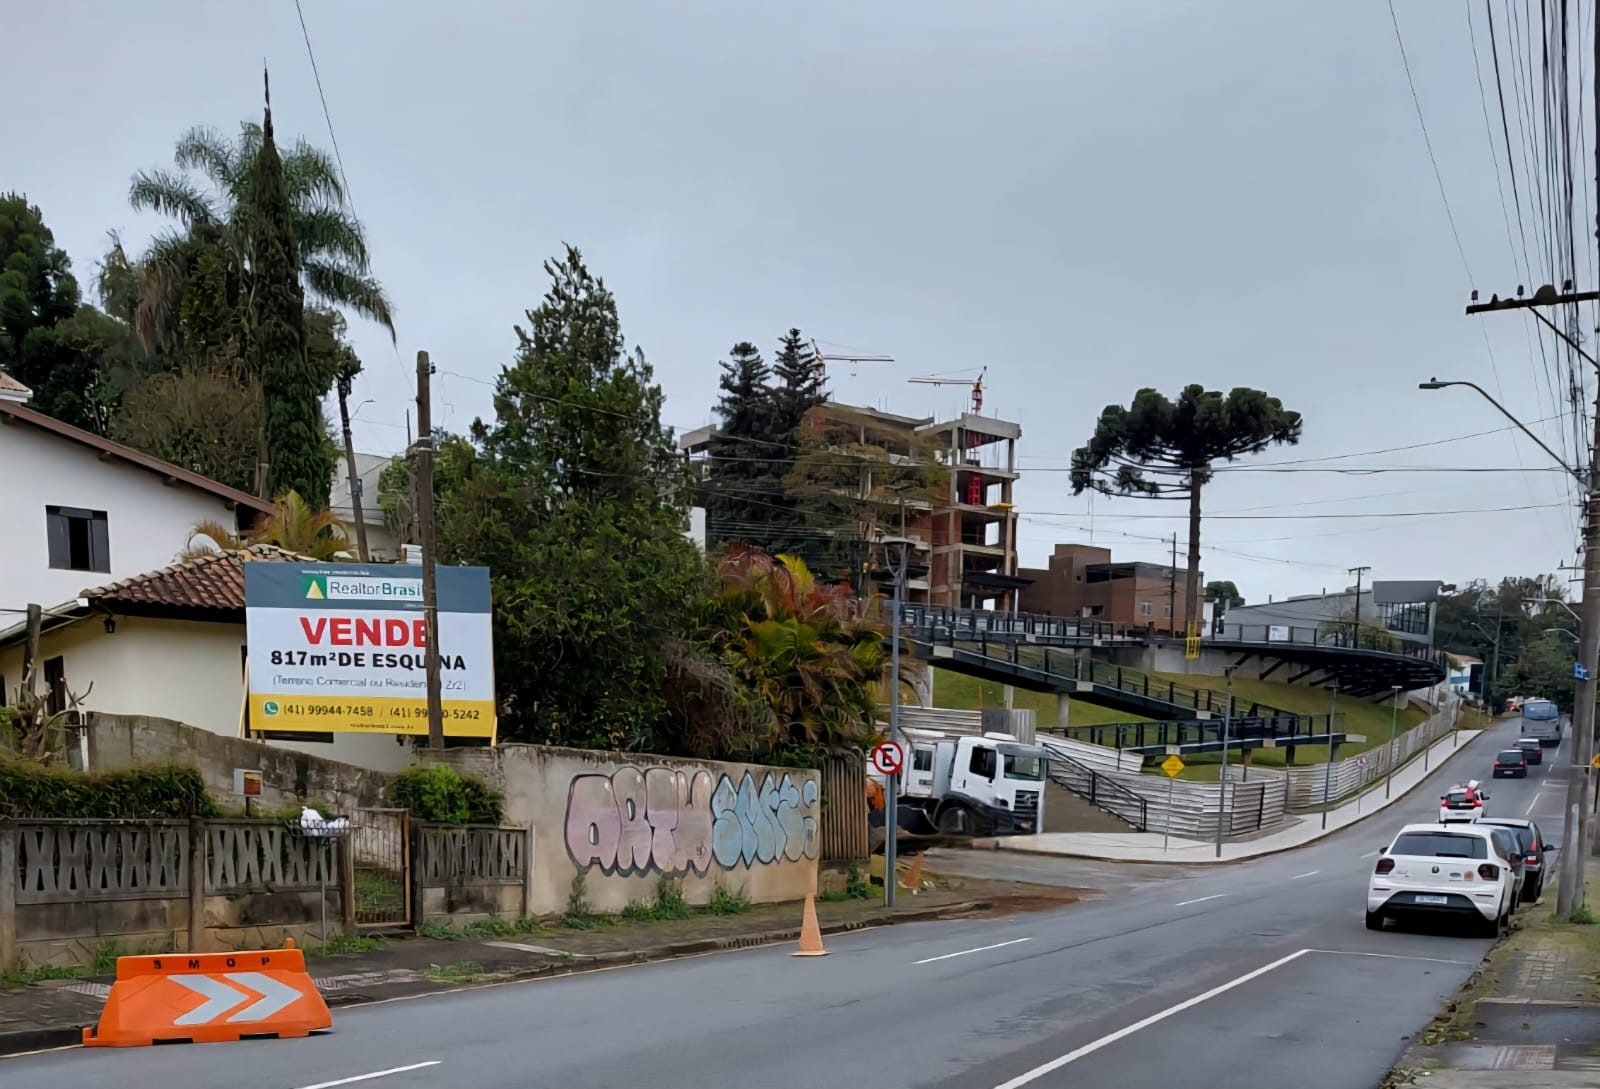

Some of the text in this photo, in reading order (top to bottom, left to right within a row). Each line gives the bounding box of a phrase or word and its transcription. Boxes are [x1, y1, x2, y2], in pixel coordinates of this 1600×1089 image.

[329, 581, 424, 597] RealtorBrasi
[372, 653, 466, 671] ESQUNA
[283, 704, 305, 716] (41)
[415, 708, 480, 720] 990-5242
